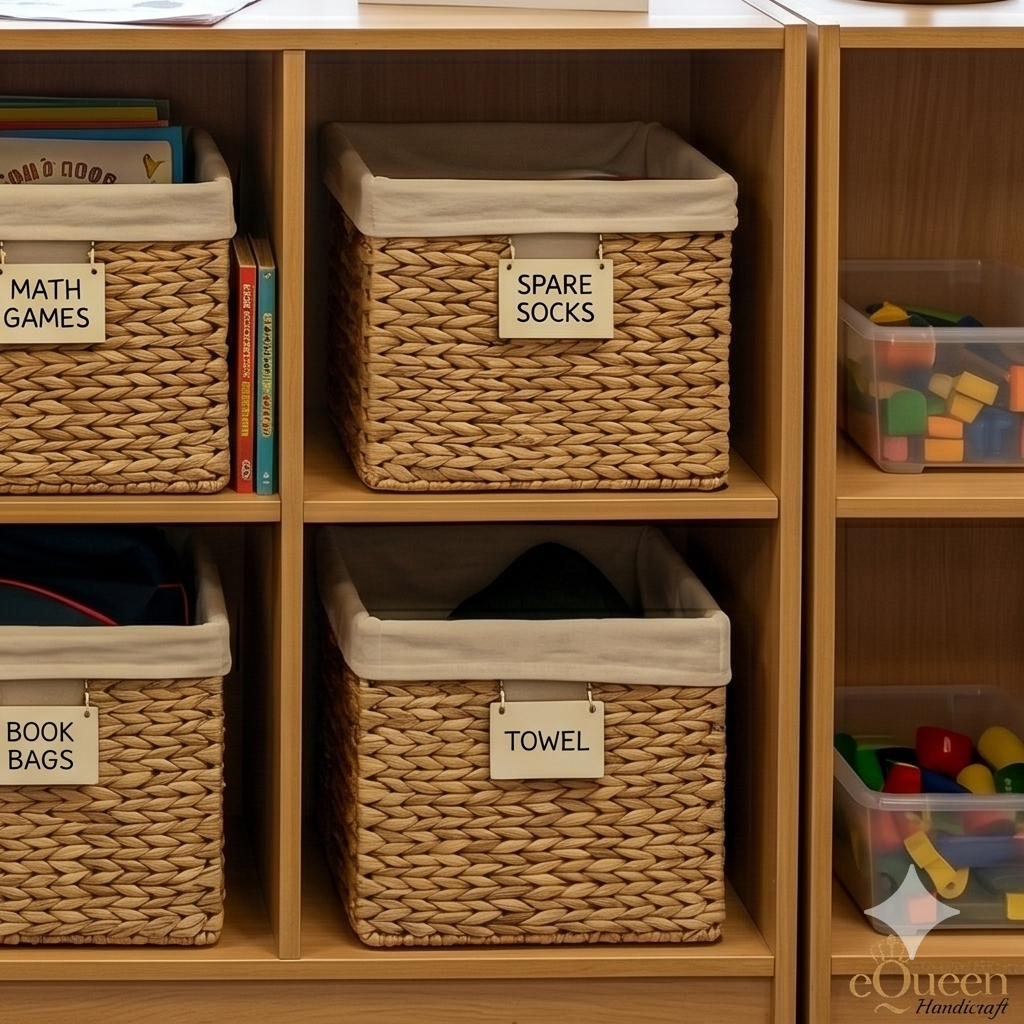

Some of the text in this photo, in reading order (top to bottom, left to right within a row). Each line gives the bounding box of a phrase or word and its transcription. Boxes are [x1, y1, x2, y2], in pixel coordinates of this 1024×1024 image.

[11, 278, 81, 300] MATH
[517, 274, 593, 295] SPARE
[3, 307, 90, 329] GAMES
[516, 301, 595, 323] SOCKS
[7, 721, 75, 743] BOOK
[504, 730, 590, 752] TOWEL
[8, 749, 74, 770] BAGS
